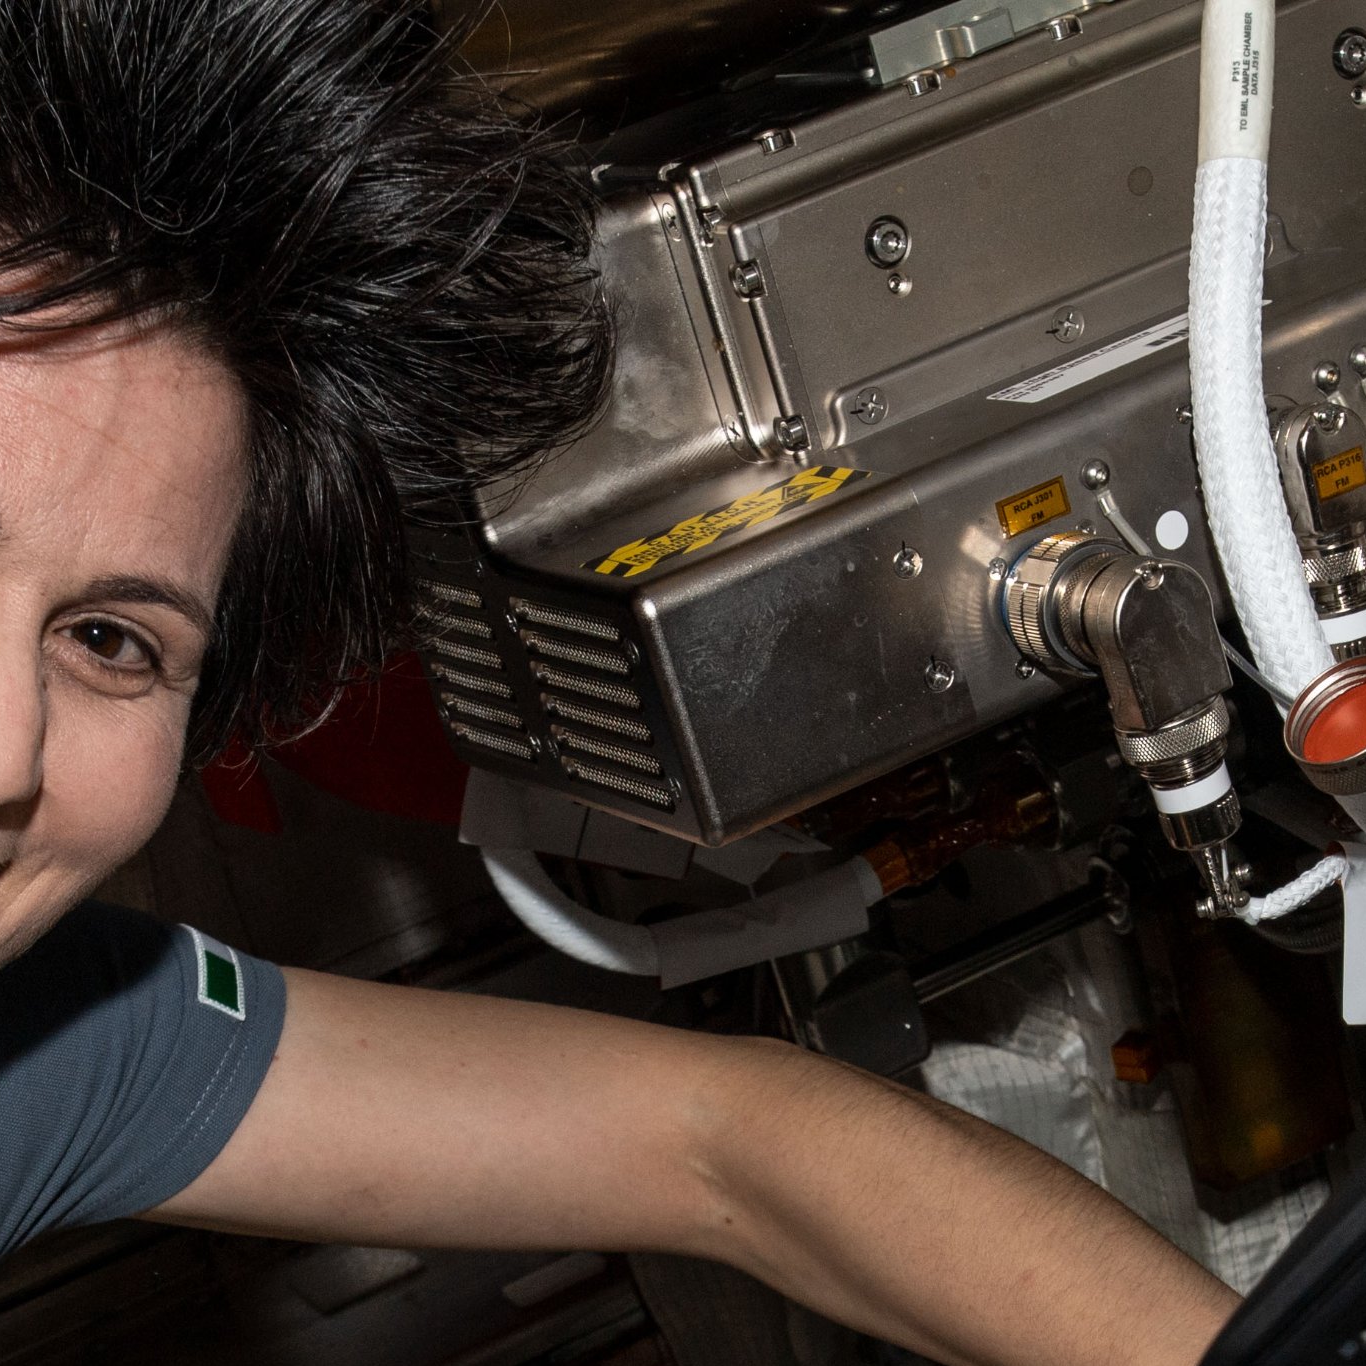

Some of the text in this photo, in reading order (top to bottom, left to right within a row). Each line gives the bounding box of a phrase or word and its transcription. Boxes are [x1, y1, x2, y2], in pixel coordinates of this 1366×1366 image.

[1239, 12, 1253, 131] TO EML SAMPLE CHAMBER
[1251, 72, 1259, 96] DATA
[1317, 463, 1338, 479] RCA
[1335, 476, 1350, 489] FM
[1013, 489, 1053, 514] RCA J301
[1031, 510, 1045, 522] FM
